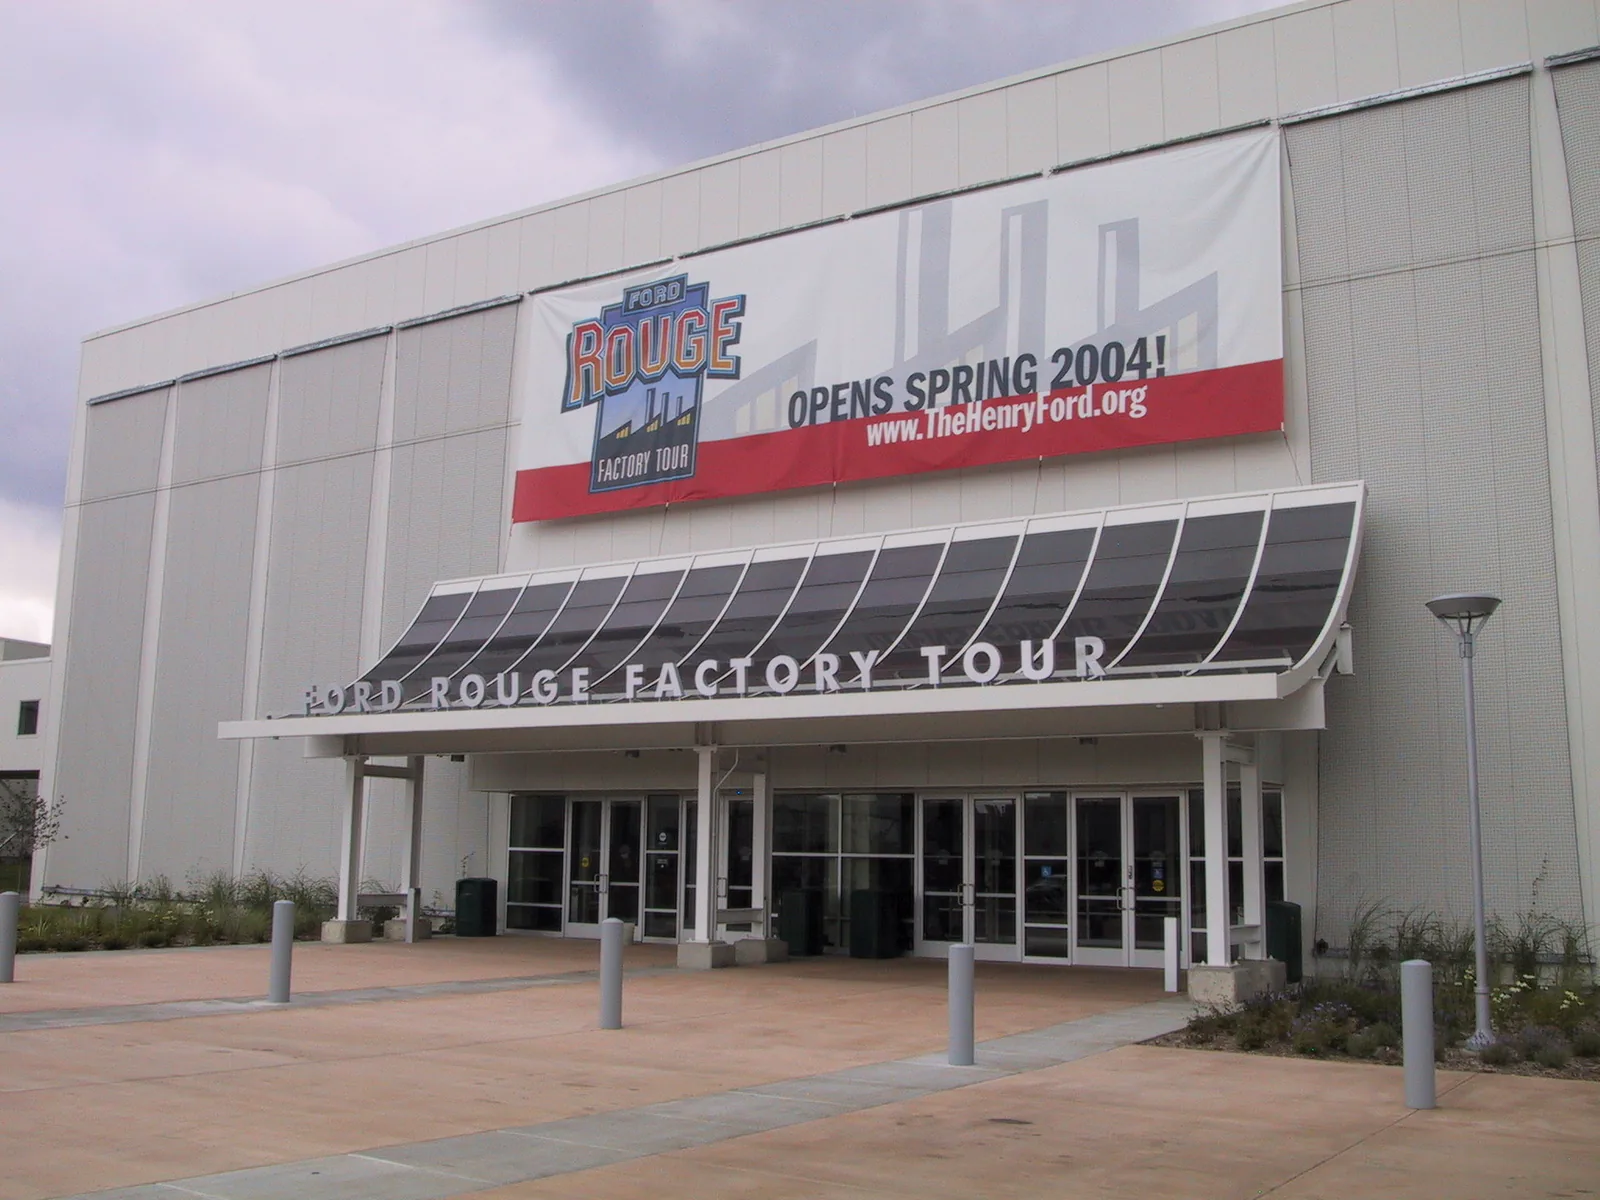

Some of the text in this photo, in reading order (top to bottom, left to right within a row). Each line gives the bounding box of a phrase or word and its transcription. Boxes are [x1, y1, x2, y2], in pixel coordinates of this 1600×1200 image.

[629, 281, 681, 310] FORD
[563, 294, 746, 410] ROUGE
[788, 335, 1167, 428] OPENS SPRING 2004!
[866, 384, 1148, 447] www.TheHenryFord.org
[597, 444, 689, 482] FACTORY TOUR
[303, 636, 1108, 715] FORD ROUGE FACTORY TOUR
